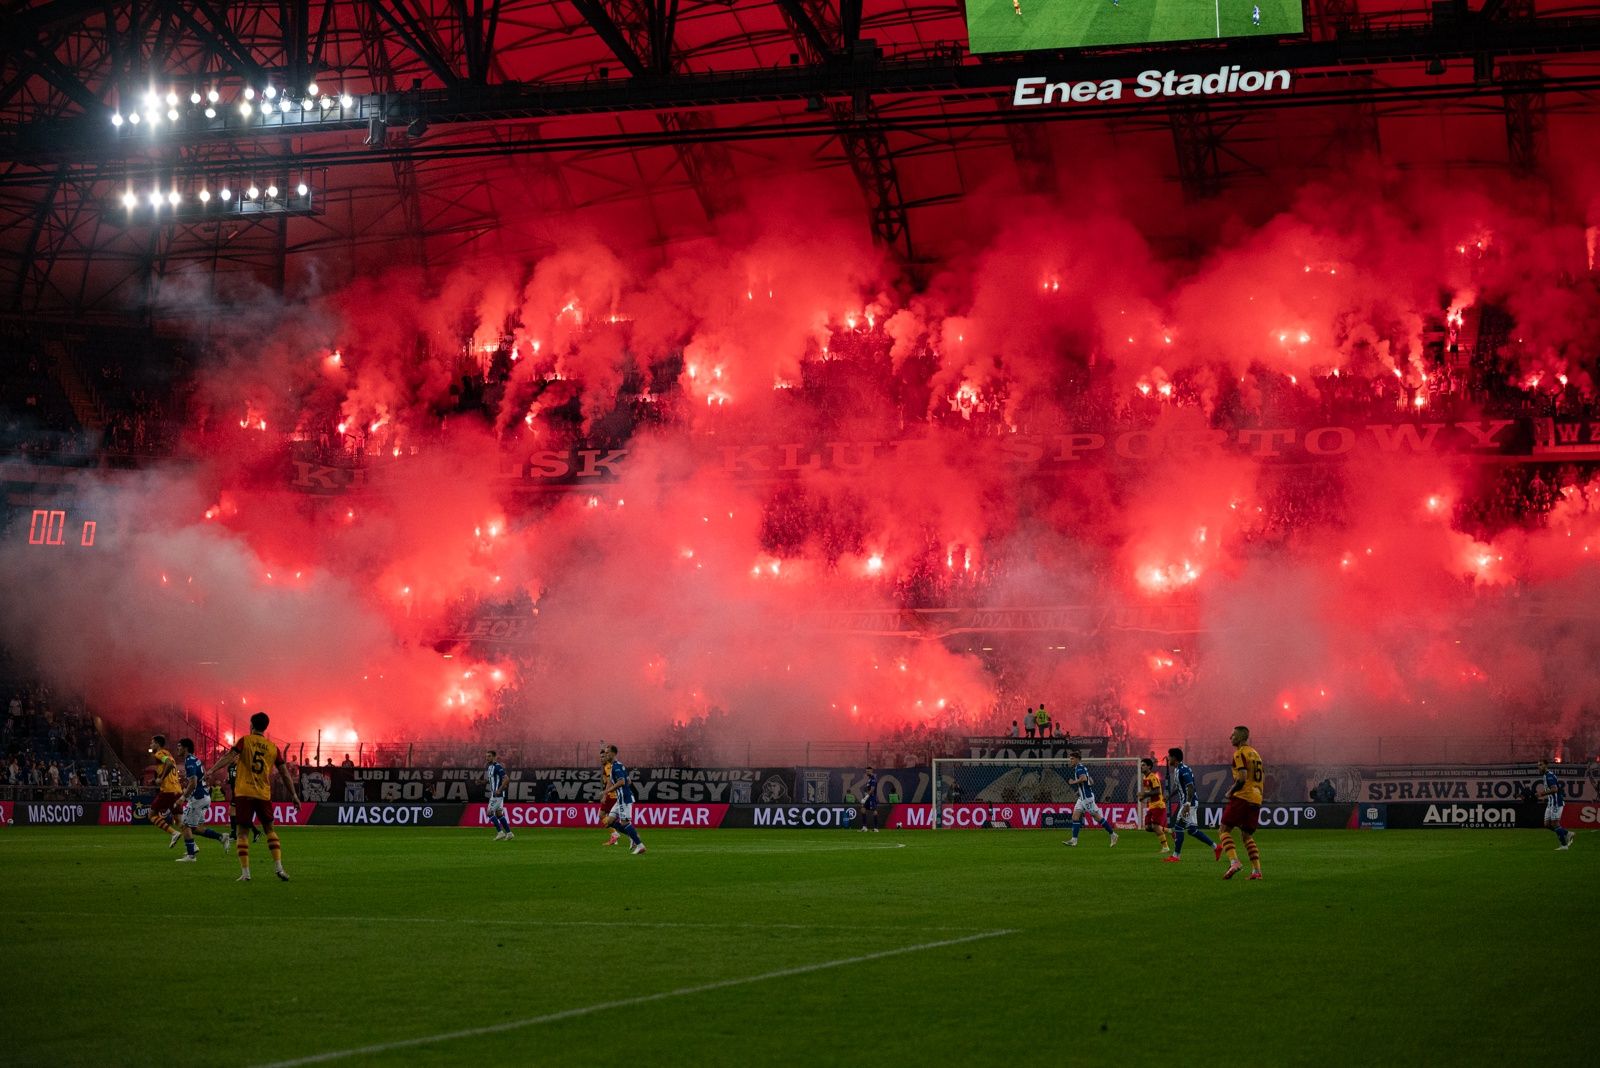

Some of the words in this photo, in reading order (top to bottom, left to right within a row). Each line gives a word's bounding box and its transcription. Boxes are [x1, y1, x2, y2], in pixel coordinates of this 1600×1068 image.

[1013, 76, 1123, 107] Enea
[1134, 65, 1291, 98] Stadion
[251, 750, 265, 775] 5
[354, 770, 390, 781] LUBI
[398, 770, 434, 781] NAS
[535, 768, 641, 782] WIĘKSZĆ
[650, 768, 761, 782] NIENAWIDZI
[553, 781, 729, 802] WSYSCY
[1368, 781, 1469, 801] SPRAWA
[584, 806, 711, 825] WKWEAR
[1204, 807, 1317, 826] MCOT®
